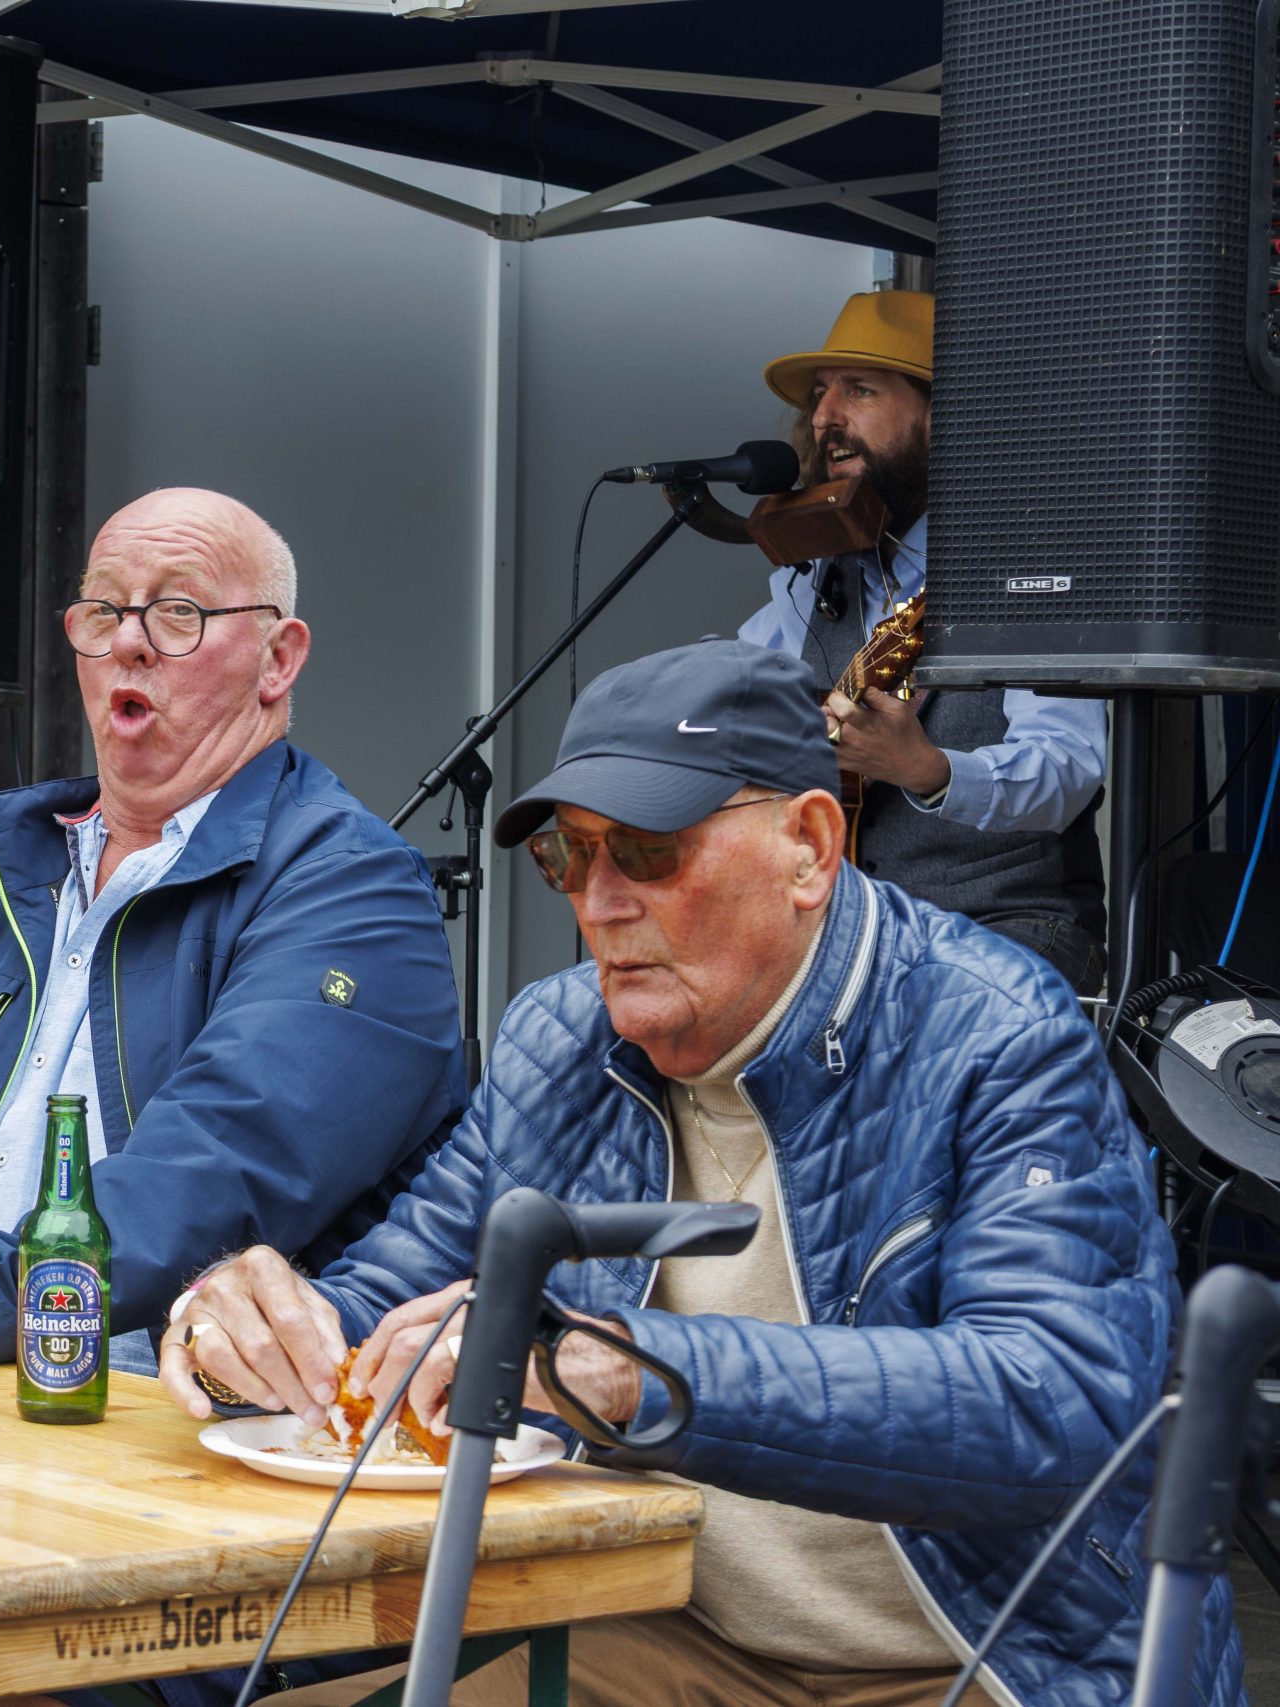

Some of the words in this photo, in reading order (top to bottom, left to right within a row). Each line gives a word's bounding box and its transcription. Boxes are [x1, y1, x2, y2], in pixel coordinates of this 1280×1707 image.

[1011, 580, 1052, 589] LINE
[1056, 579, 1068, 588] 6
[60, 1160, 68, 1197] Heineken
[29, 1272, 65, 1303] HEINEKEN
[67, 1272, 82, 1286] 0.0
[80, 1280, 95, 1305] BEER
[24, 1312, 100, 1332] Heineken
[28, 1350, 46, 1373] PURE
[45, 1366, 70, 1379] MALT
[72, 1351, 94, 1376] LAGER
